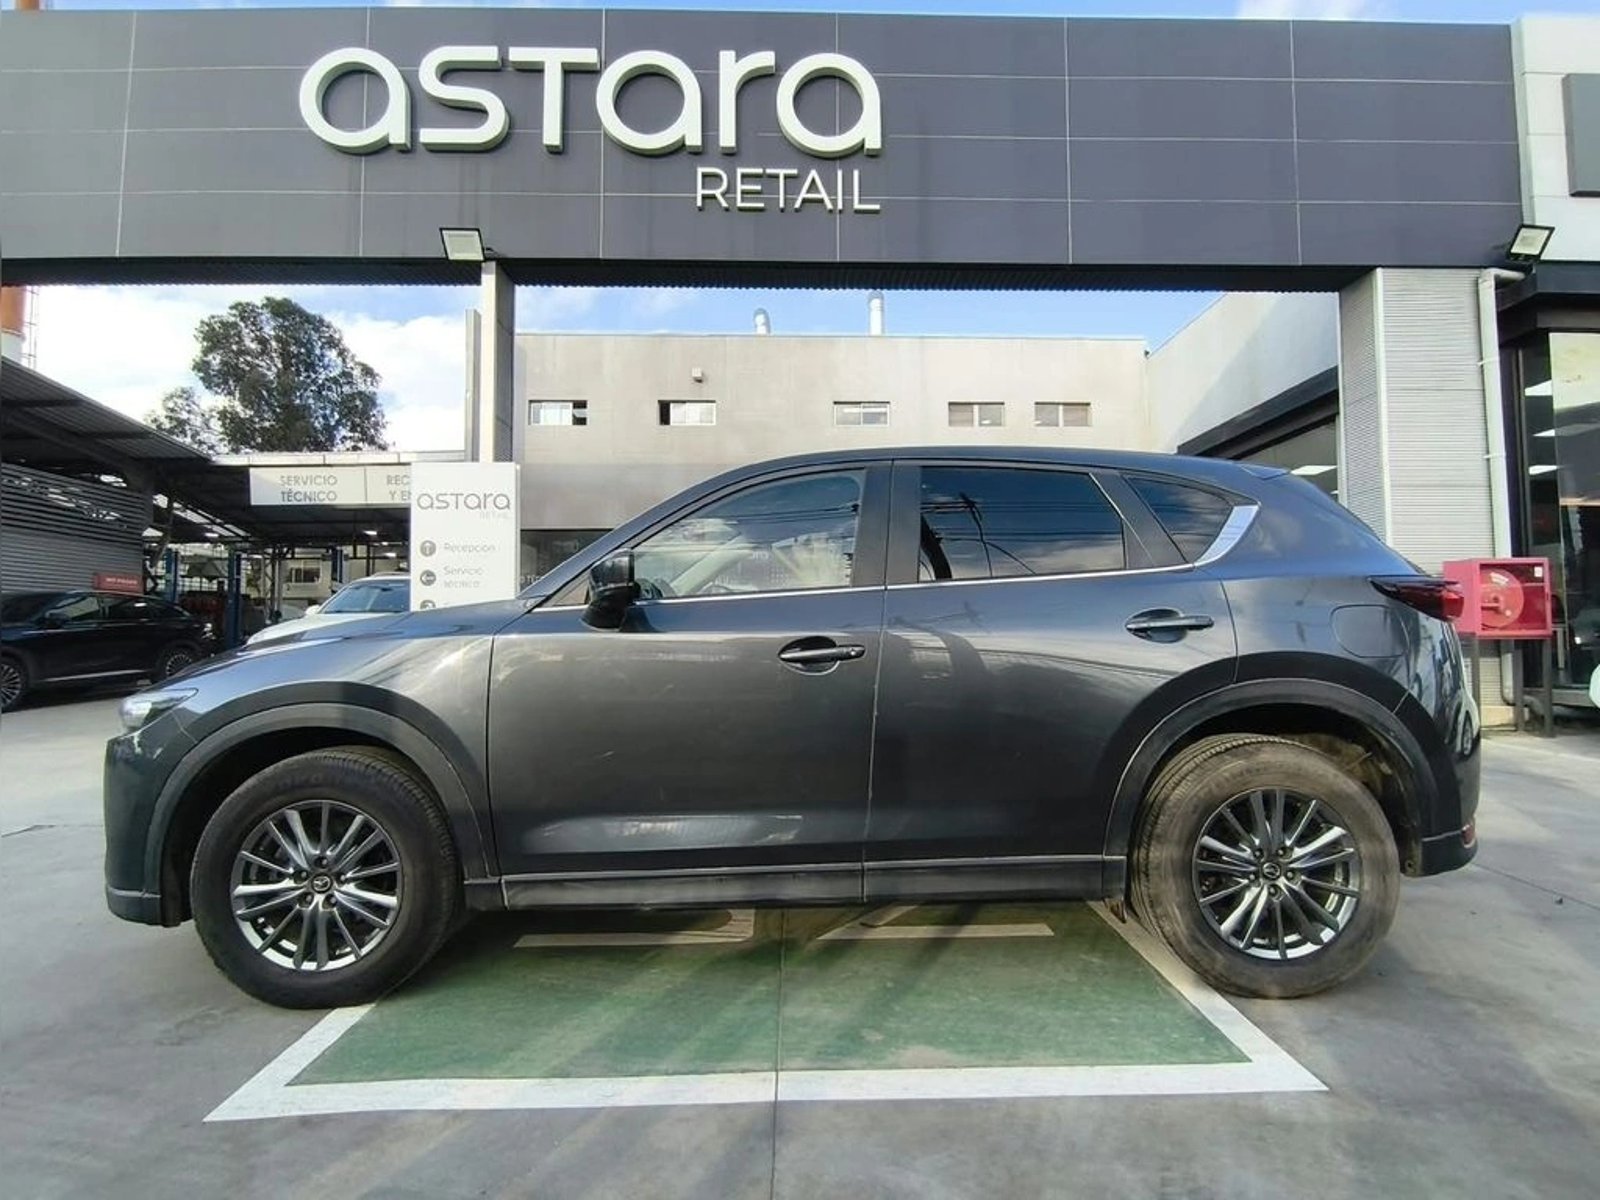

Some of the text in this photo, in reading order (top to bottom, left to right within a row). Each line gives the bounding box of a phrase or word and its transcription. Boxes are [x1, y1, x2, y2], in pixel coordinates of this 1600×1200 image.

[695, 166, 881, 213] RETAIL
[280, 474, 338, 486] SERVICIO
[280, 488, 338, 502] TÉCNICO
[388, 489, 396, 500] Y
